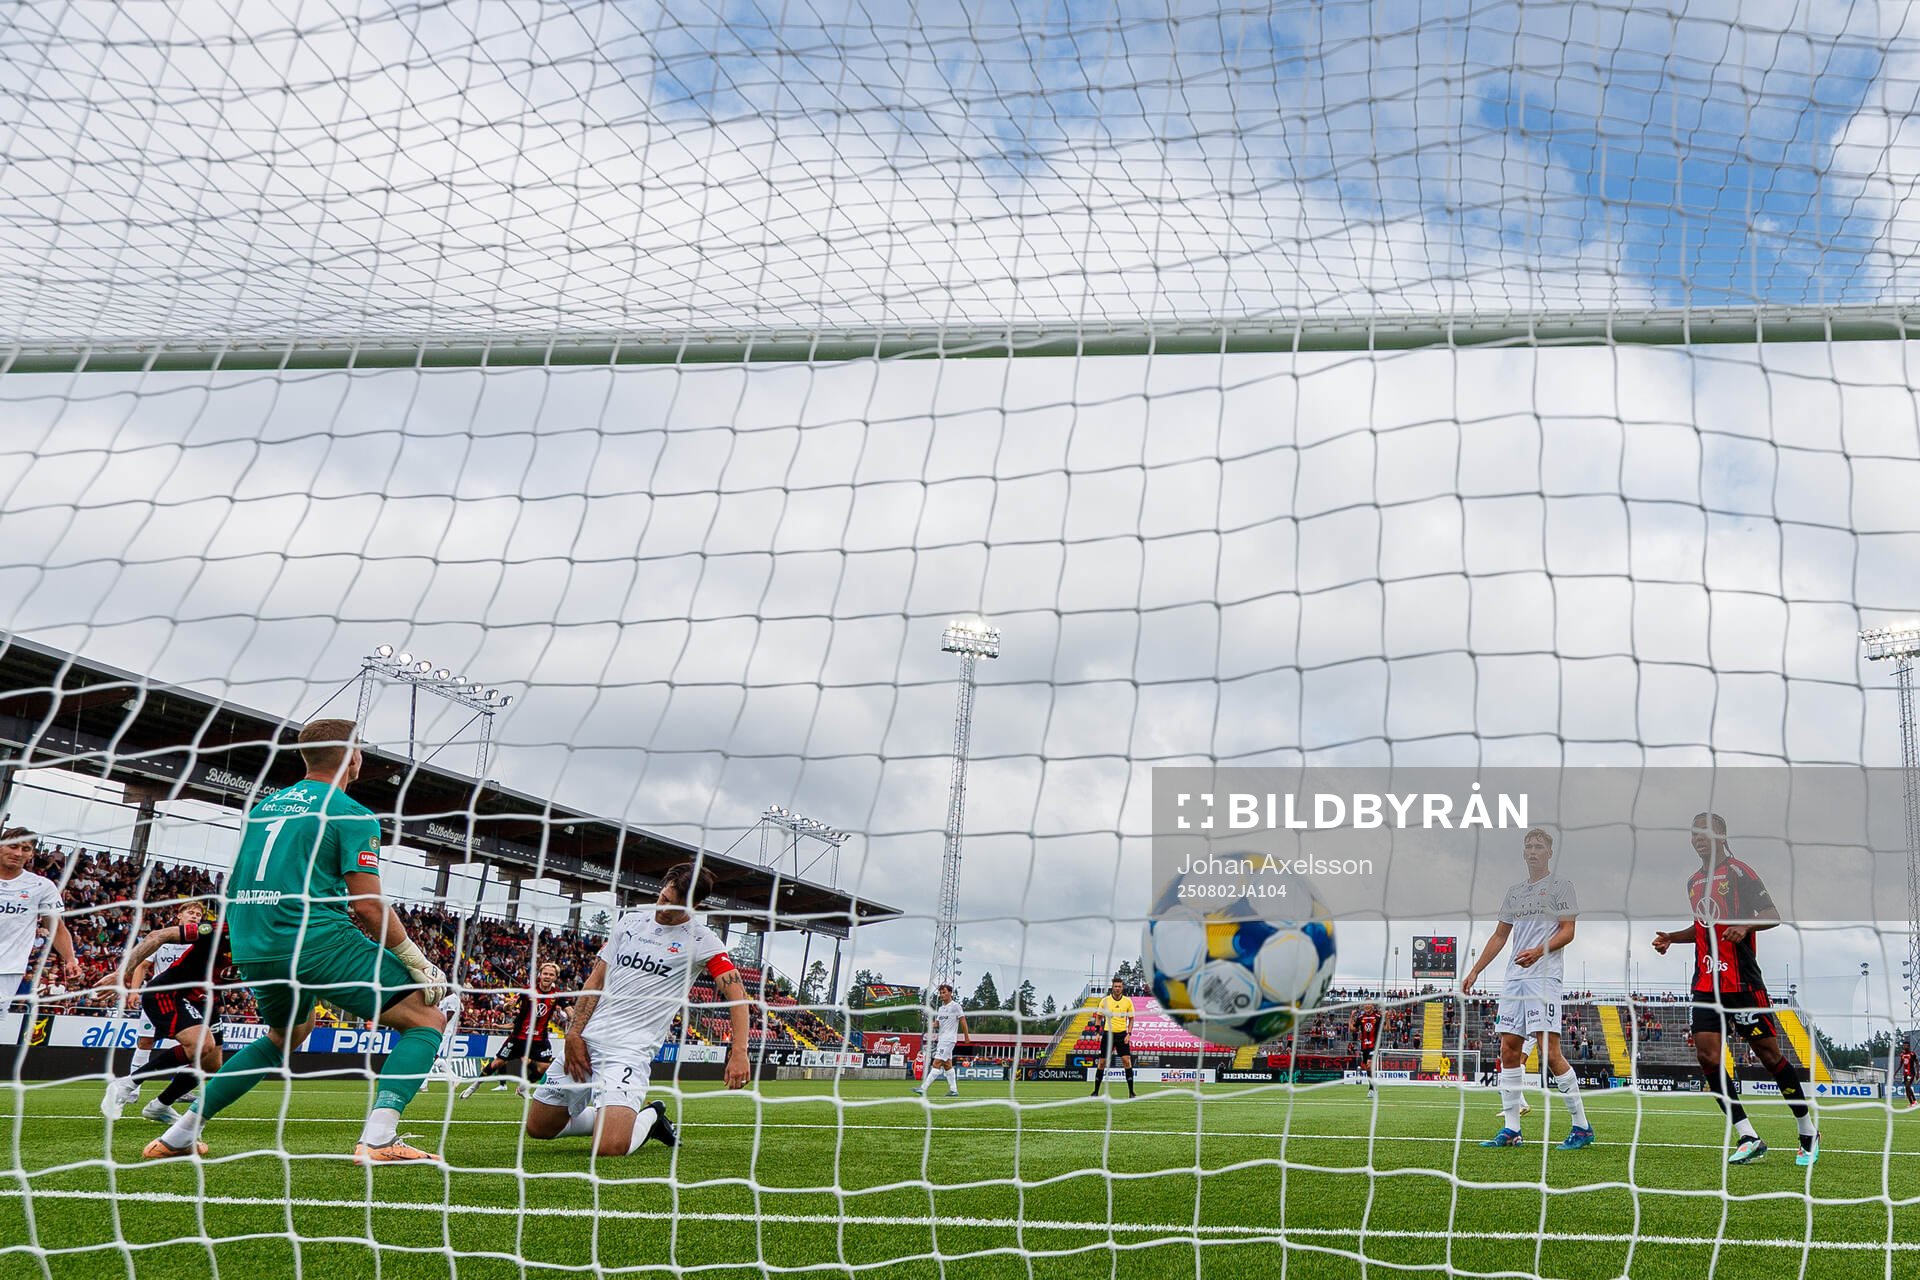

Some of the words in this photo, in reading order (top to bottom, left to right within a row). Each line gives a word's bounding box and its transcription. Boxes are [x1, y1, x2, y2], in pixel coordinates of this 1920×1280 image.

[255, 818, 287, 881] 1
[616, 952, 673, 978] vobbiz
[622, 1066, 633, 1084] 2
[1831, 1086, 1872, 1096] INAB
